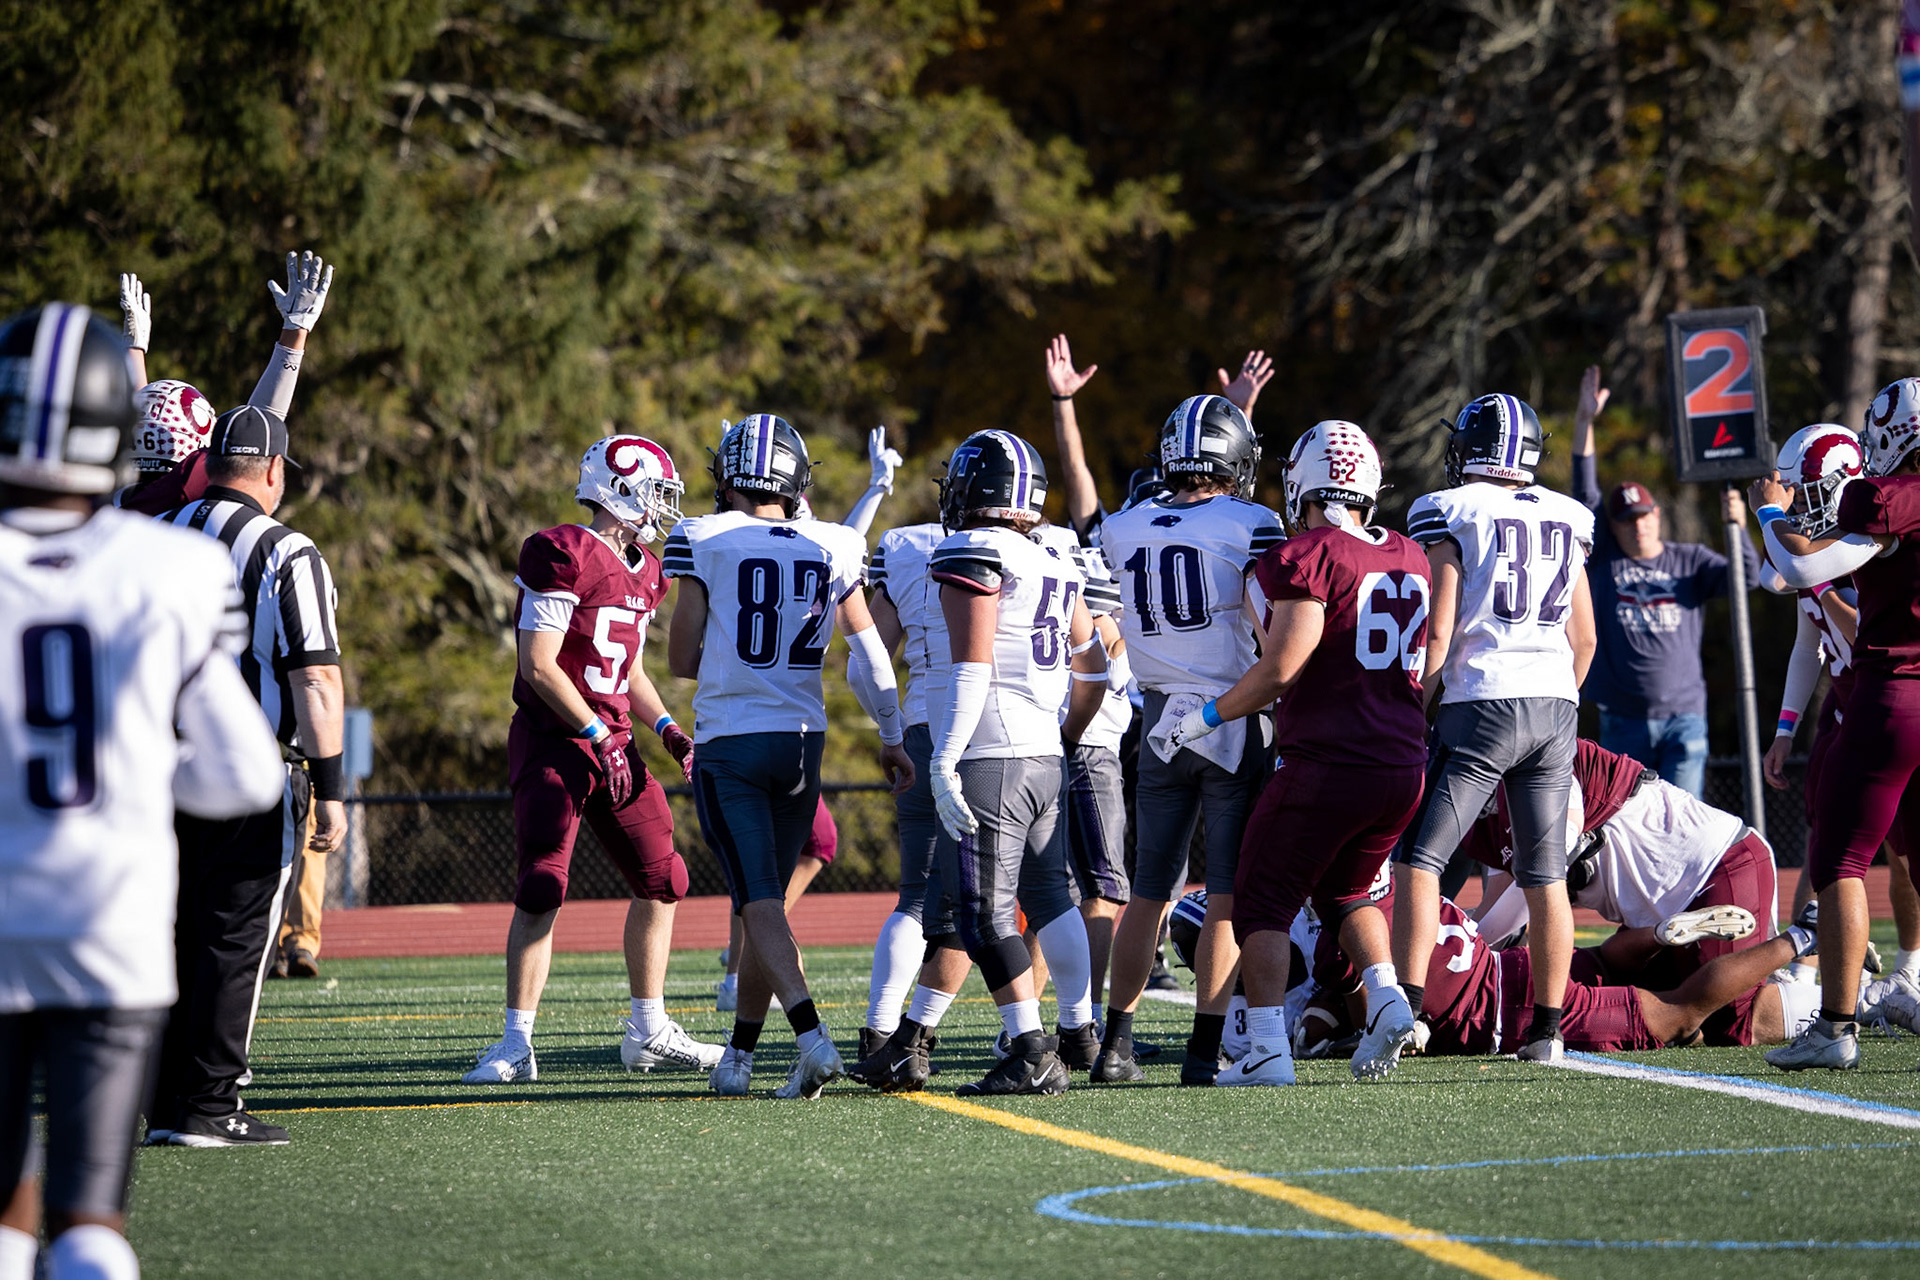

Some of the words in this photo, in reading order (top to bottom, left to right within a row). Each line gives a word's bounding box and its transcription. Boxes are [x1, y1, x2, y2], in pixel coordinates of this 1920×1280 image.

[1682, 328, 1756, 419] 2
[733, 477, 781, 492] Riddell
[1168, 460, 1213, 473] Riddell
[1329, 460, 1356, 483] 62
[1486, 467, 1523, 479] Riddell
[737, 558, 834, 670] 82
[1125, 545, 1212, 637] 10
[1493, 518, 1575, 627] 32
[1355, 571, 1431, 682] 62
[22, 623, 97, 810] 9
